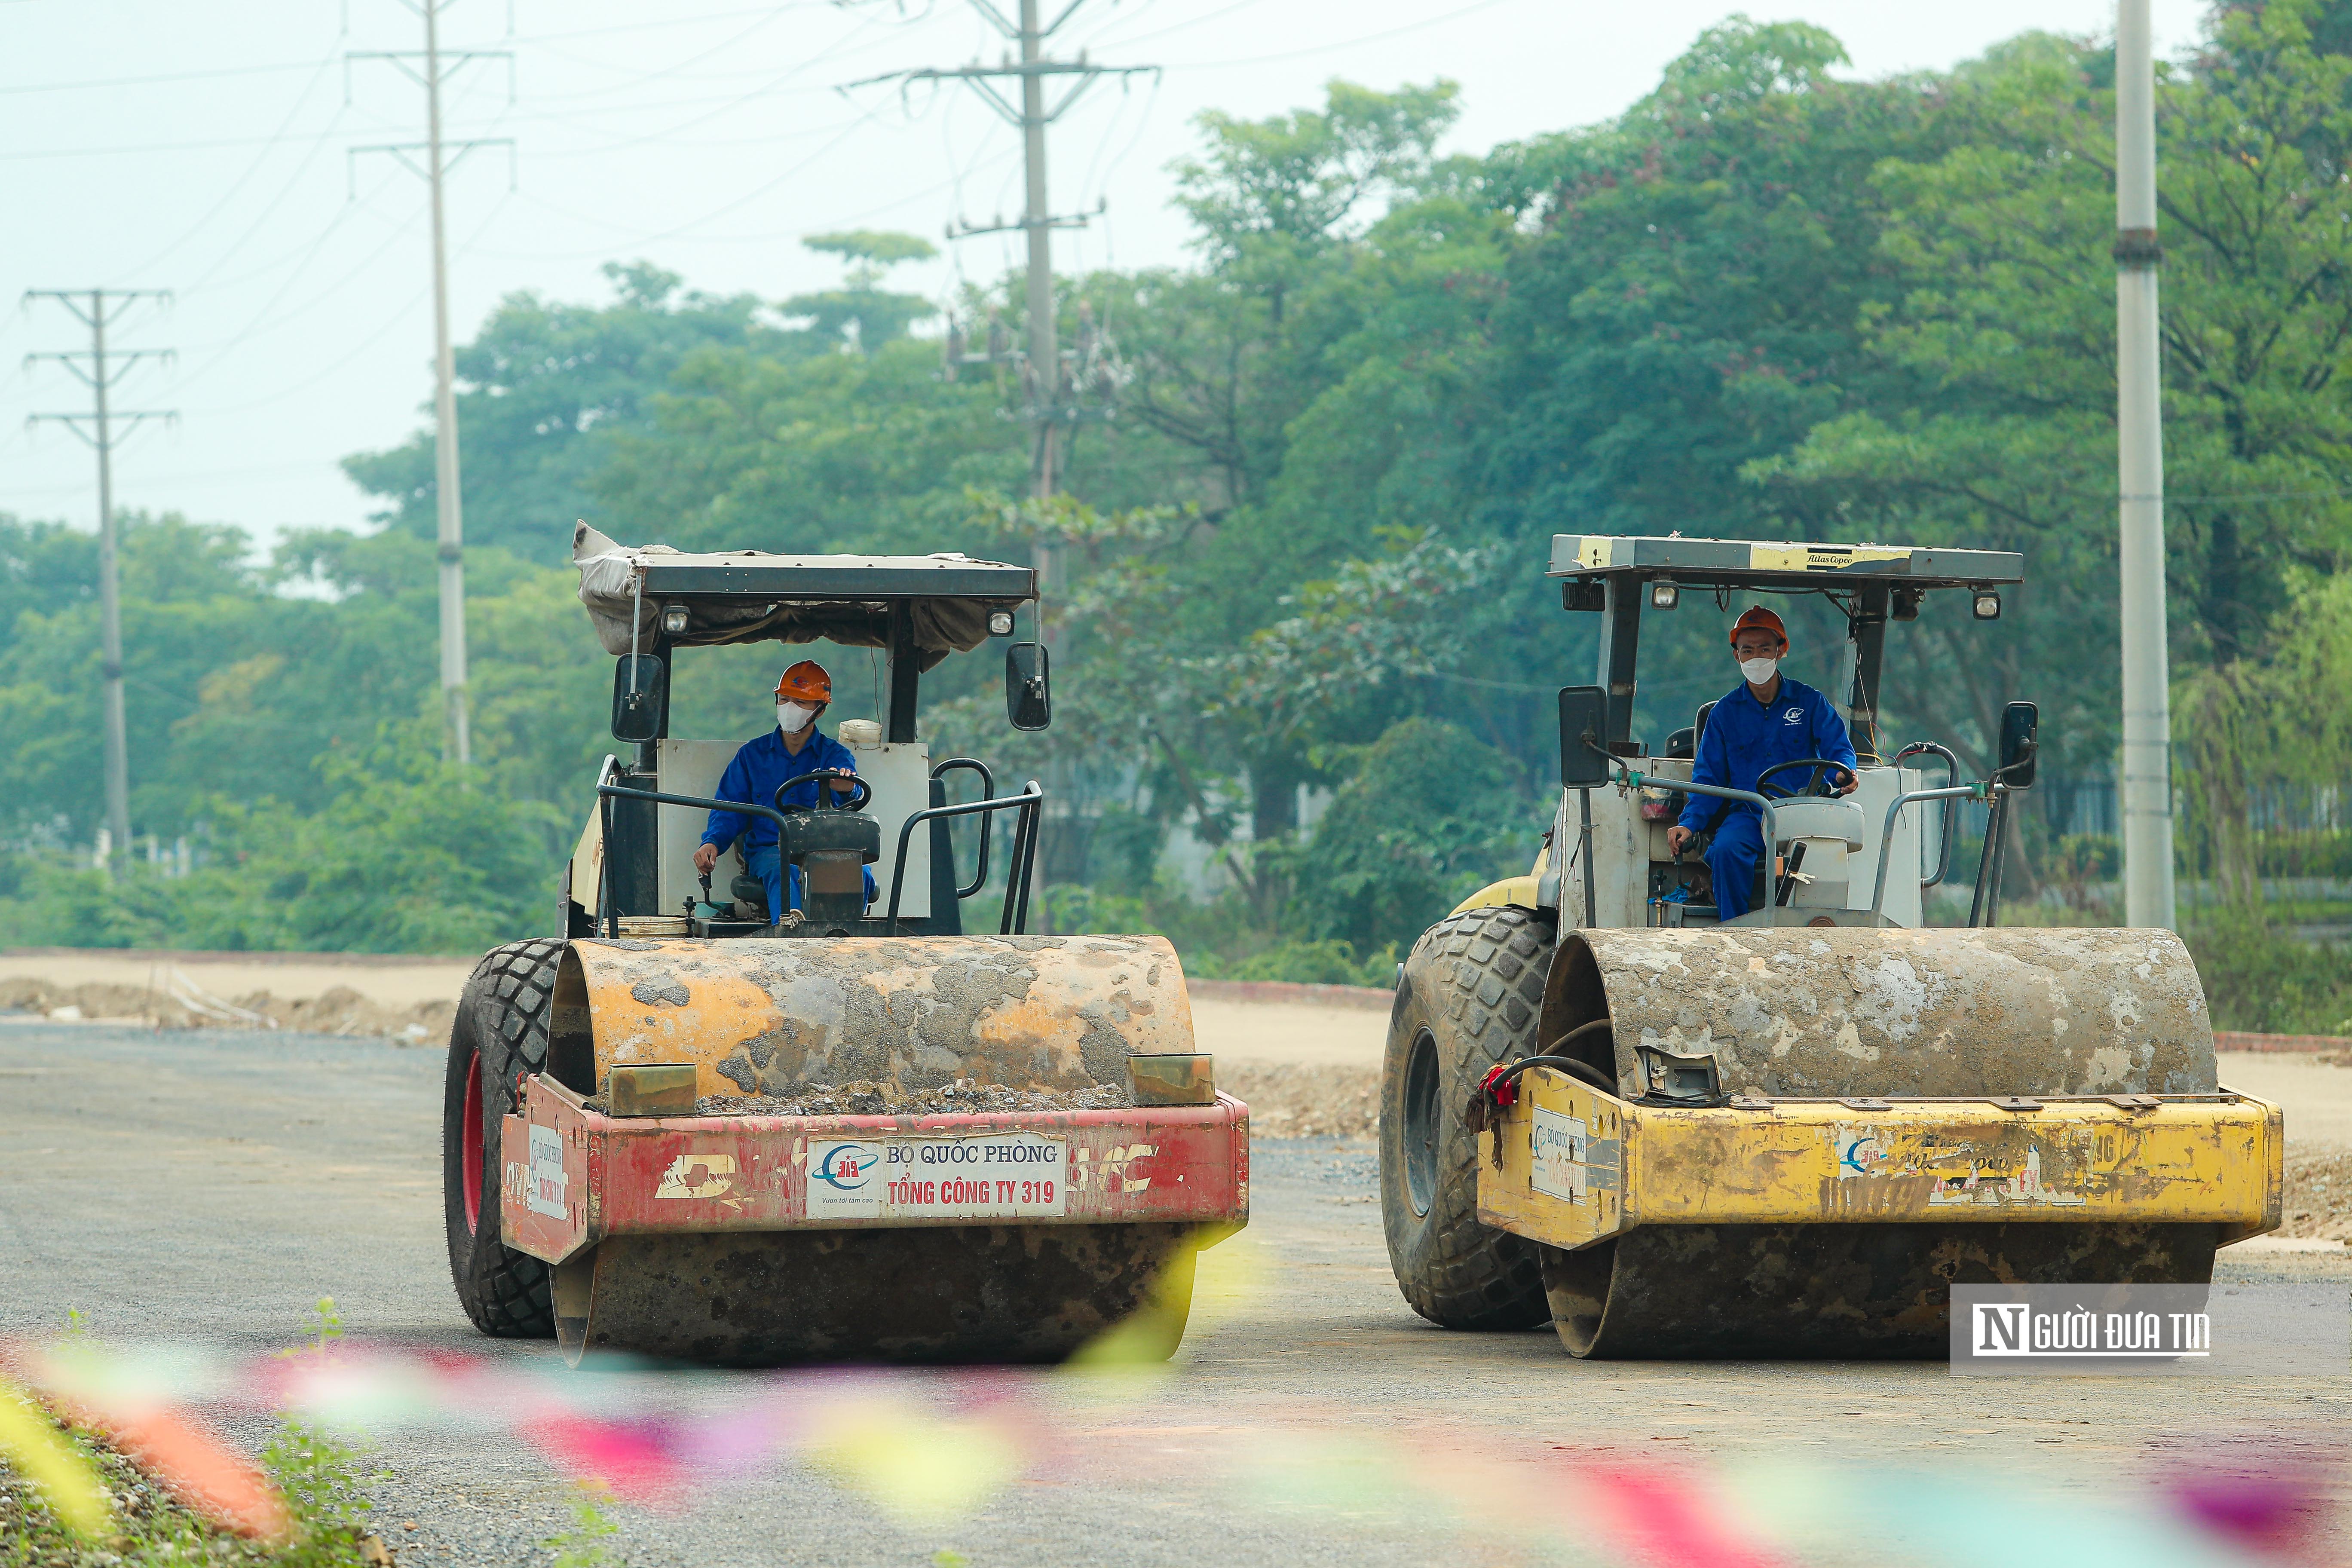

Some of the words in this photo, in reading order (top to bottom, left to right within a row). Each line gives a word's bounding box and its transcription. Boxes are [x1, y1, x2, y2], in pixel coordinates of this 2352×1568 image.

[1830, 556, 1852, 564] Copco
[1548, 1124, 1554, 1148] BỘ
[1555, 1126, 1568, 1148] QUỐC
[886, 1141, 914, 1168] BỘ
[921, 1138, 978, 1164] QUỐC
[984, 1139, 1057, 1163] PHÒNG
[837, 1161, 859, 1178] 319
[888, 1172, 934, 1204] TỔNG
[941, 1176, 989, 1204] CÔNG
[995, 1181, 1016, 1204] TY
[1021, 1181, 1054, 1204] 319
